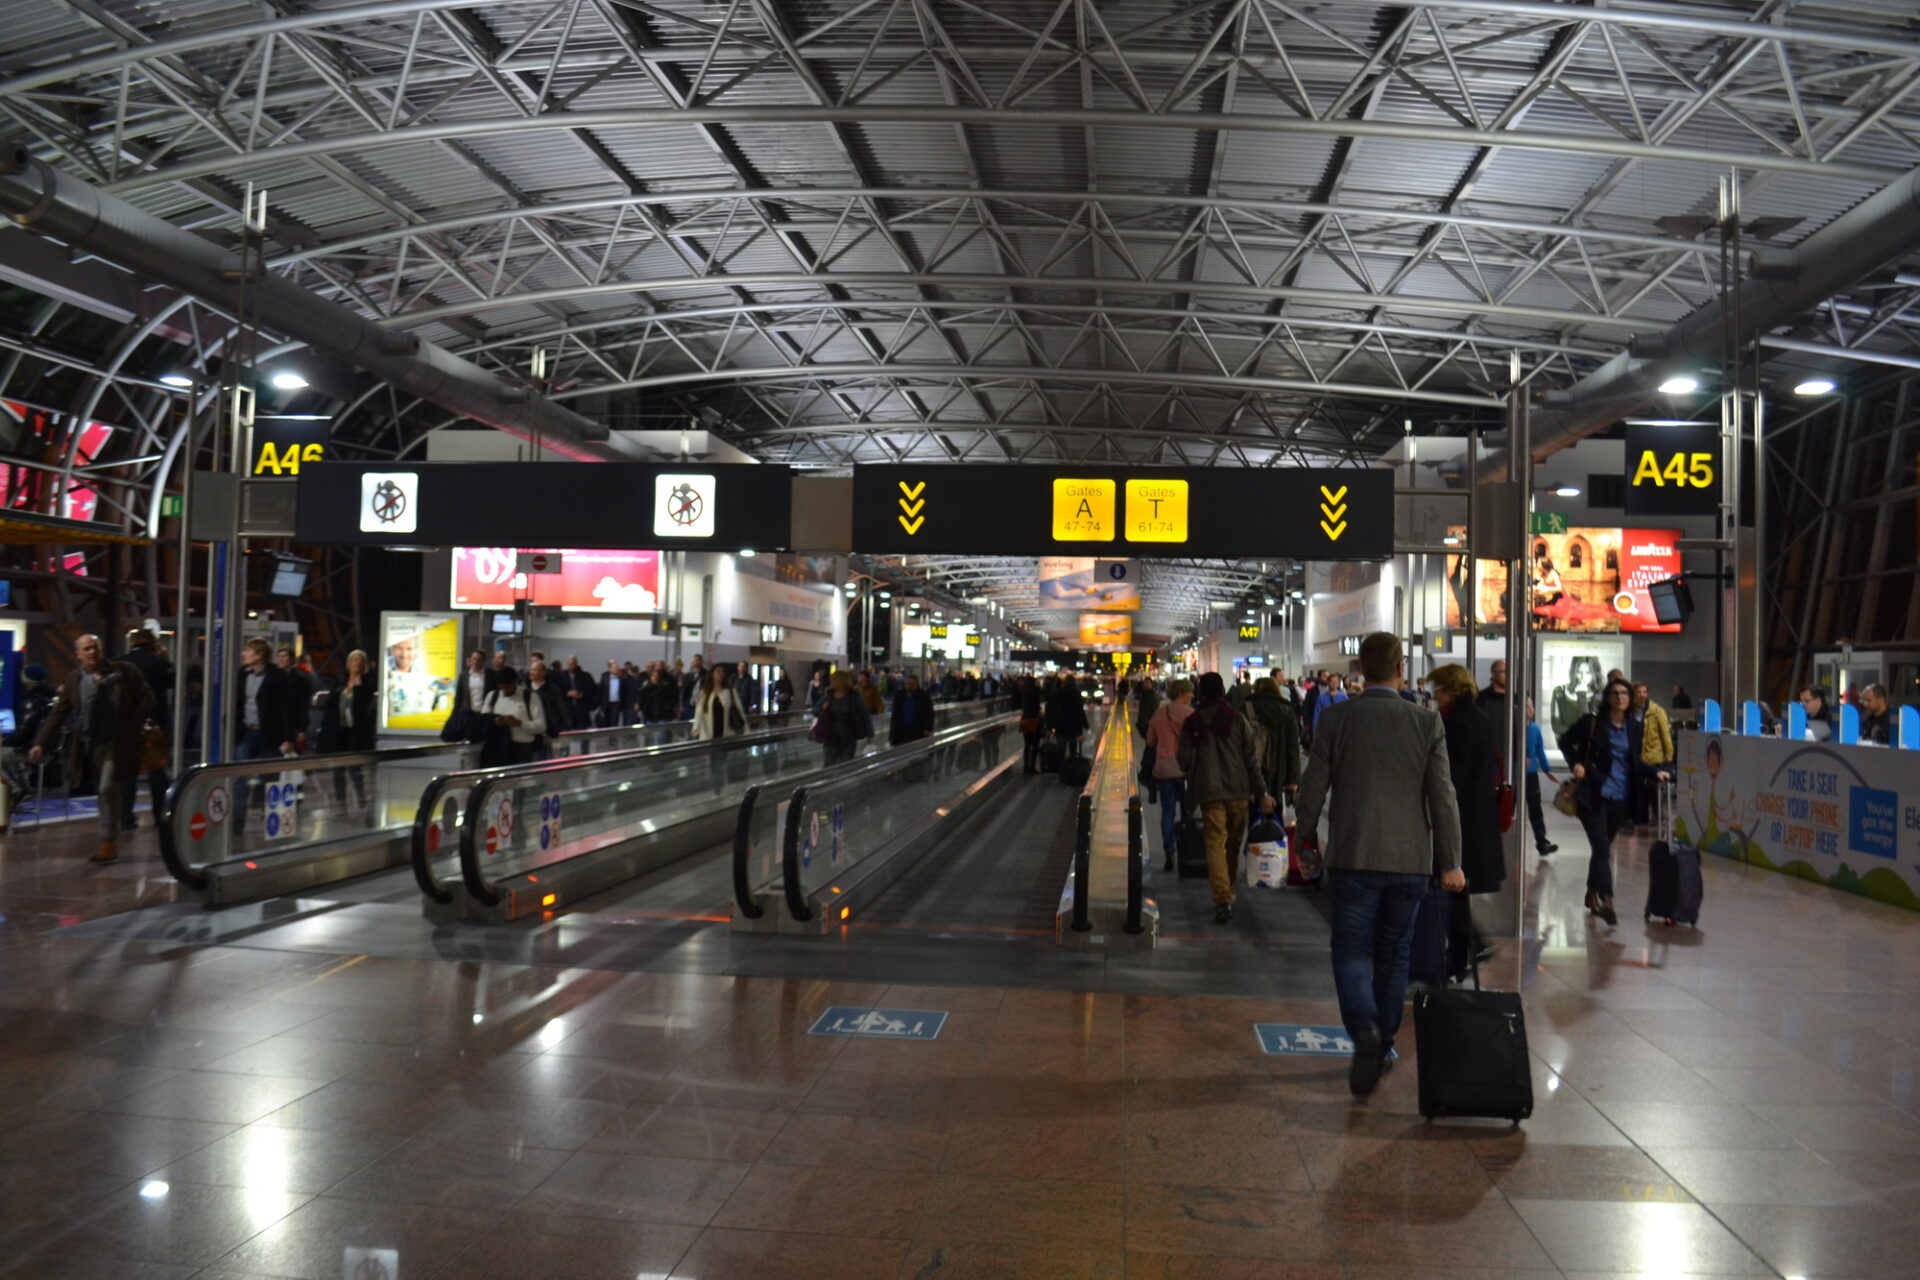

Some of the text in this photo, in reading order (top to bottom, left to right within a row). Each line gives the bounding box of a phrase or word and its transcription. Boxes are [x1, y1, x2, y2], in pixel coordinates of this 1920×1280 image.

[253, 441, 325, 475] A46
[1632, 449, 1714, 488] A45
[1065, 485, 1103, 497] Gates
[1138, 486, 1176, 498] Gates
[1076, 498, 1093, 519] A
[1148, 499, 1164, 519] T
[1064, 521, 1101, 532] 47-74
[1138, 522, 1174, 533] 61-74
[1239, 625, 1260, 637] A47
[1788, 768, 1839, 796] TAKE A SEAT.
[1755, 791, 1839, 827] CHARGE YOUR PHONE
[1861, 816, 1893, 832] got the
[1771, 821, 1839, 856] OR LAPTOP HERE
